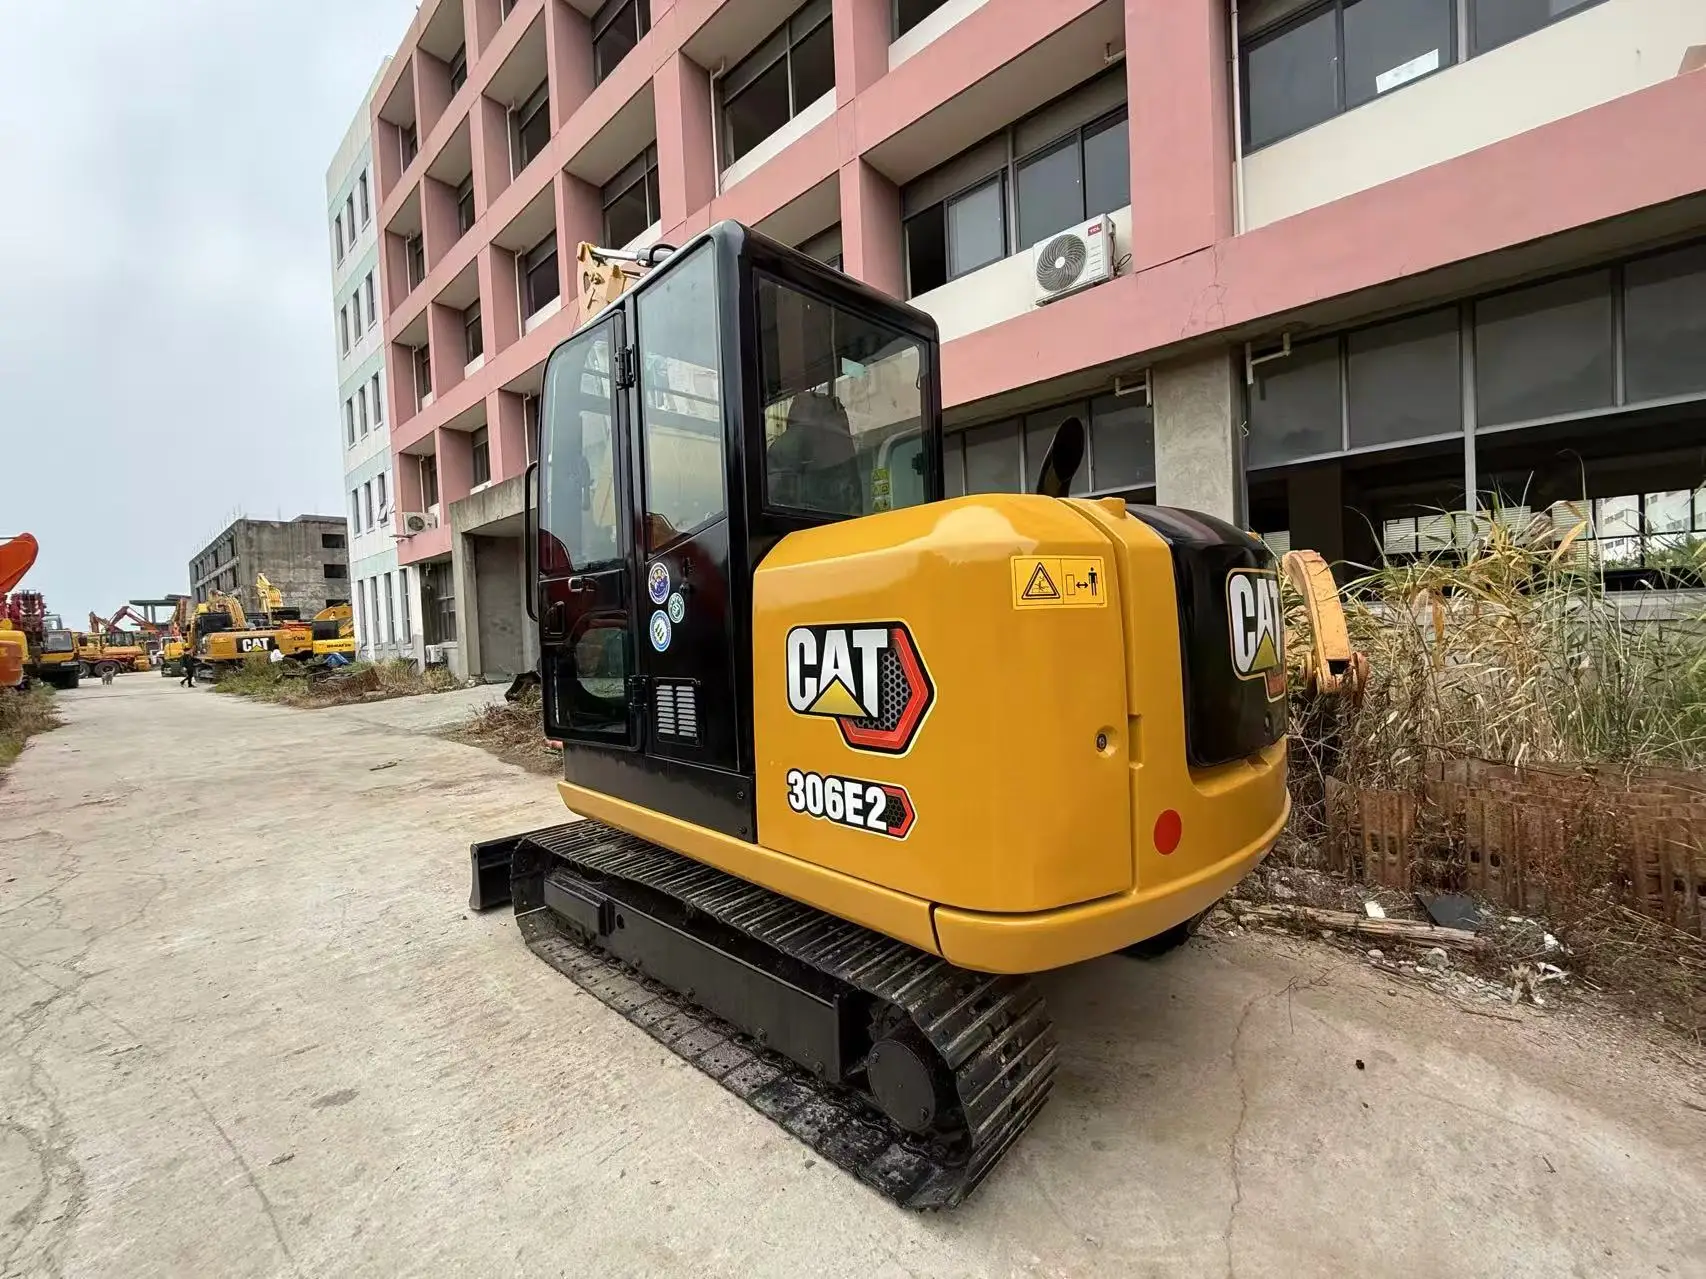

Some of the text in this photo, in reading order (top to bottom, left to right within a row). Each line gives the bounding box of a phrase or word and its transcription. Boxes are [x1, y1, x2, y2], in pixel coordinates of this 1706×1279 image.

[242, 637, 269, 651] CAT
[1229, 574, 1281, 673] CAT
[787, 627, 888, 718] CAT
[787, 769, 888, 832] 306E2
